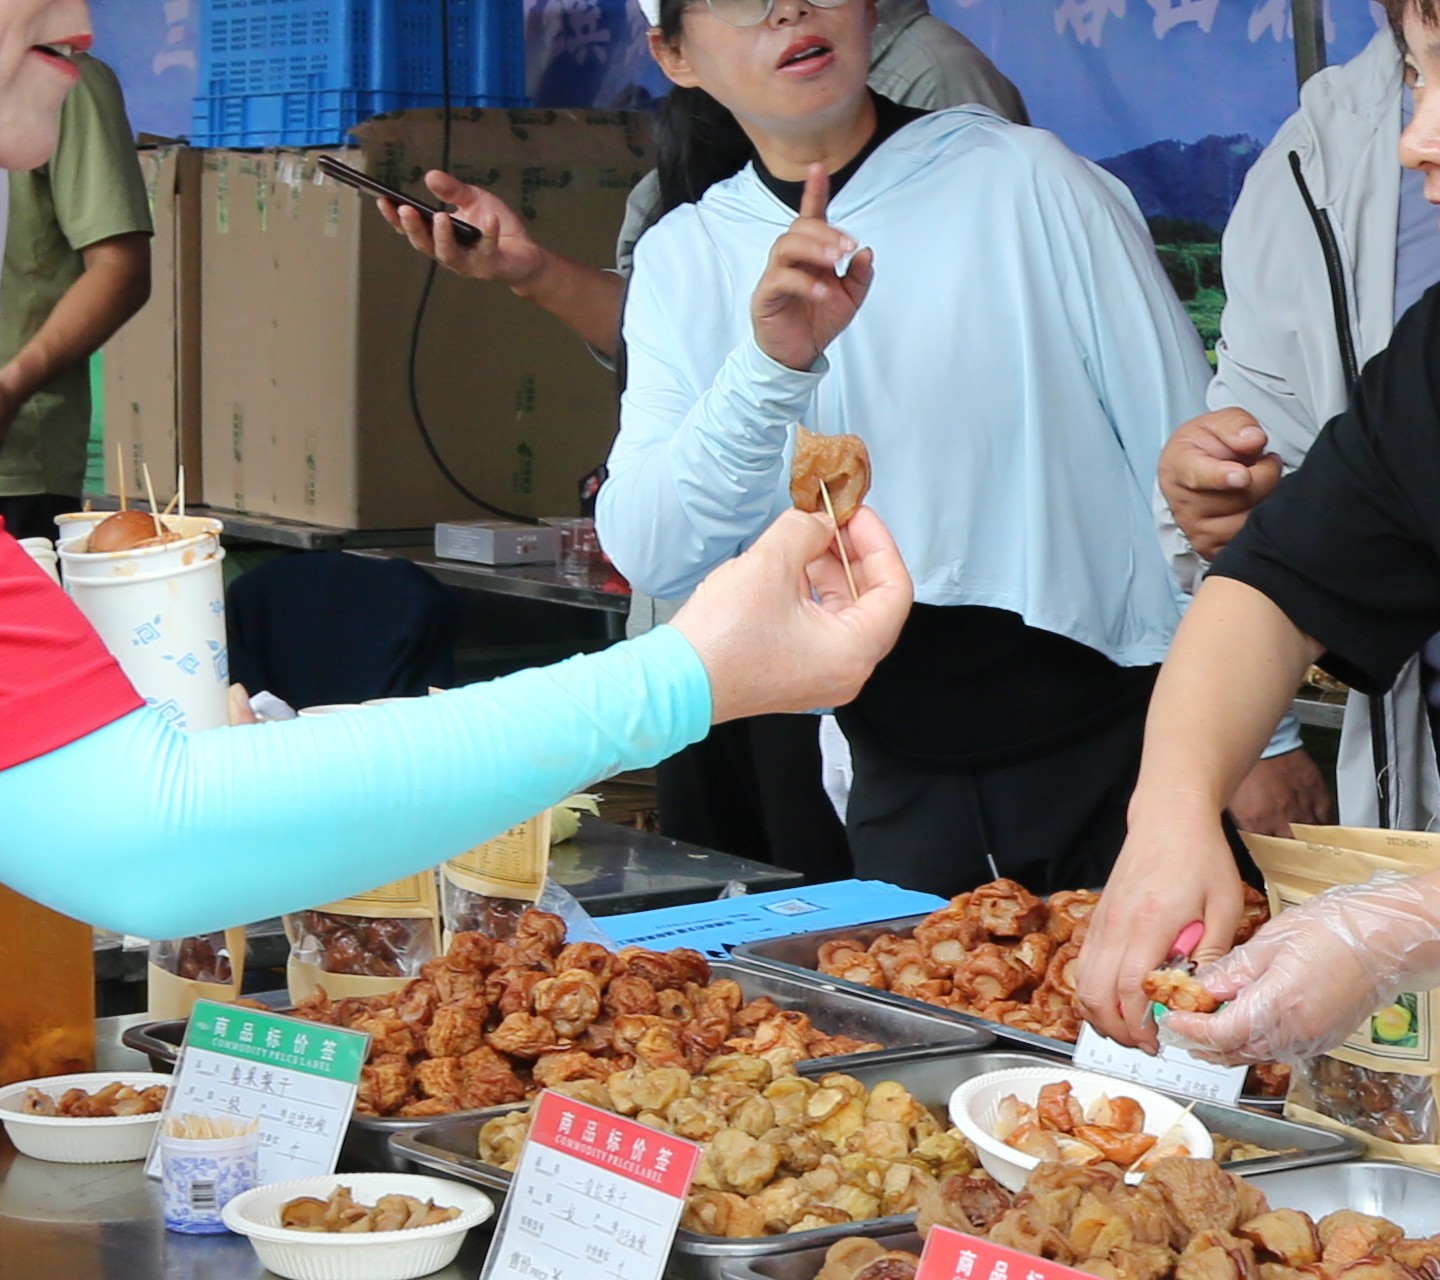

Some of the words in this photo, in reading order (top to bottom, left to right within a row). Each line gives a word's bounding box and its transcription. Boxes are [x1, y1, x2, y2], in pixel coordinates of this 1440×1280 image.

[214, 1016, 337, 1061] 商品标价签
[558, 1111, 672, 1173] 商品标价签
